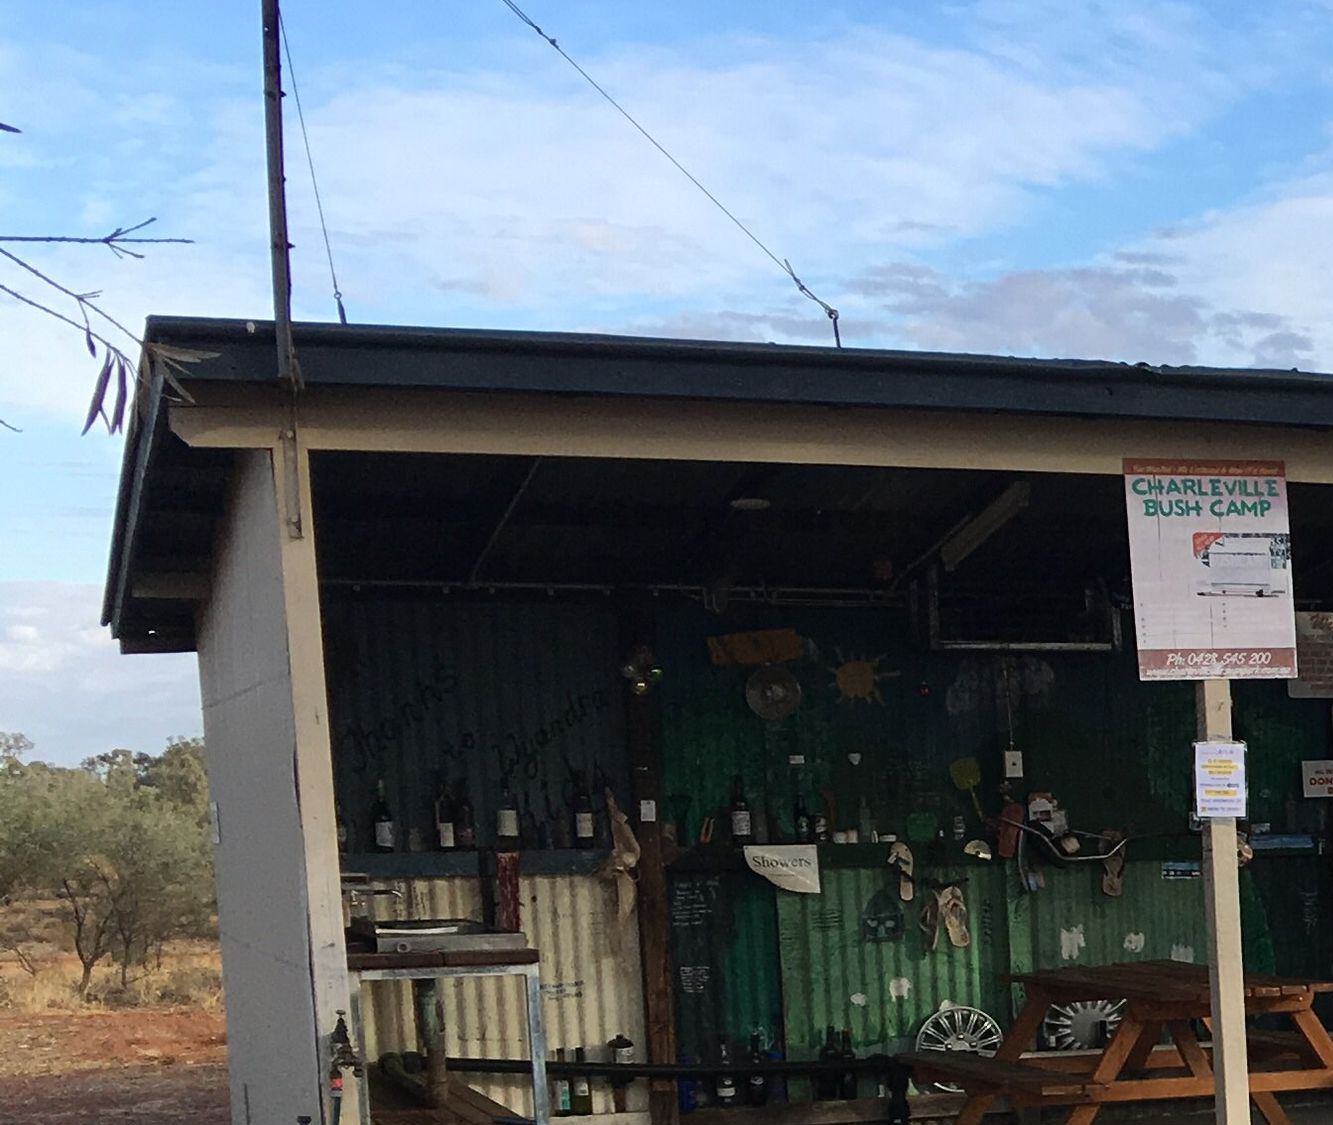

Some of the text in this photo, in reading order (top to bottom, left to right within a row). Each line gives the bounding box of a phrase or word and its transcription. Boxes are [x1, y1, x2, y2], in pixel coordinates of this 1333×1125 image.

[1131, 478, 1280, 498] CHARLEVILLE
[1143, 498, 1272, 518] BUSH CAMP
[1187, 652, 1219, 666] 0428
[1220, 651, 1246, 665] 545
[1249, 651, 1272, 665] 200
[751, 855, 813, 869] Showers
